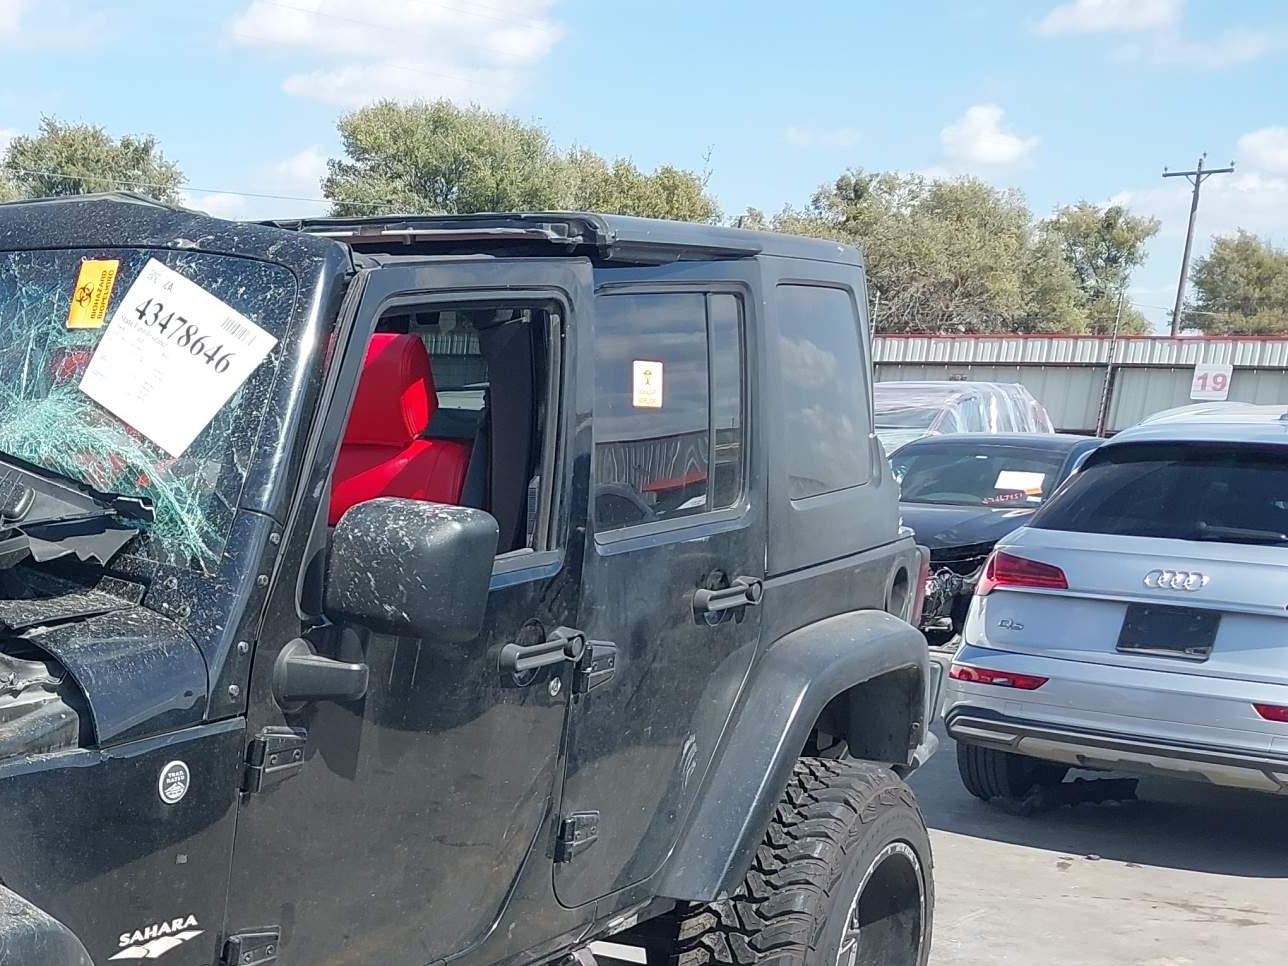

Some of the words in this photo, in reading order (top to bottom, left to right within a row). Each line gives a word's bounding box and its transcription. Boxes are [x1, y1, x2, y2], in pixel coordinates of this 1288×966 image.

[90, 270, 108, 320] BIOHAZARD
[135, 297, 236, 374] 43478646
[1197, 372, 1227, 392] 19
[119, 914, 199, 947] SAHARA
